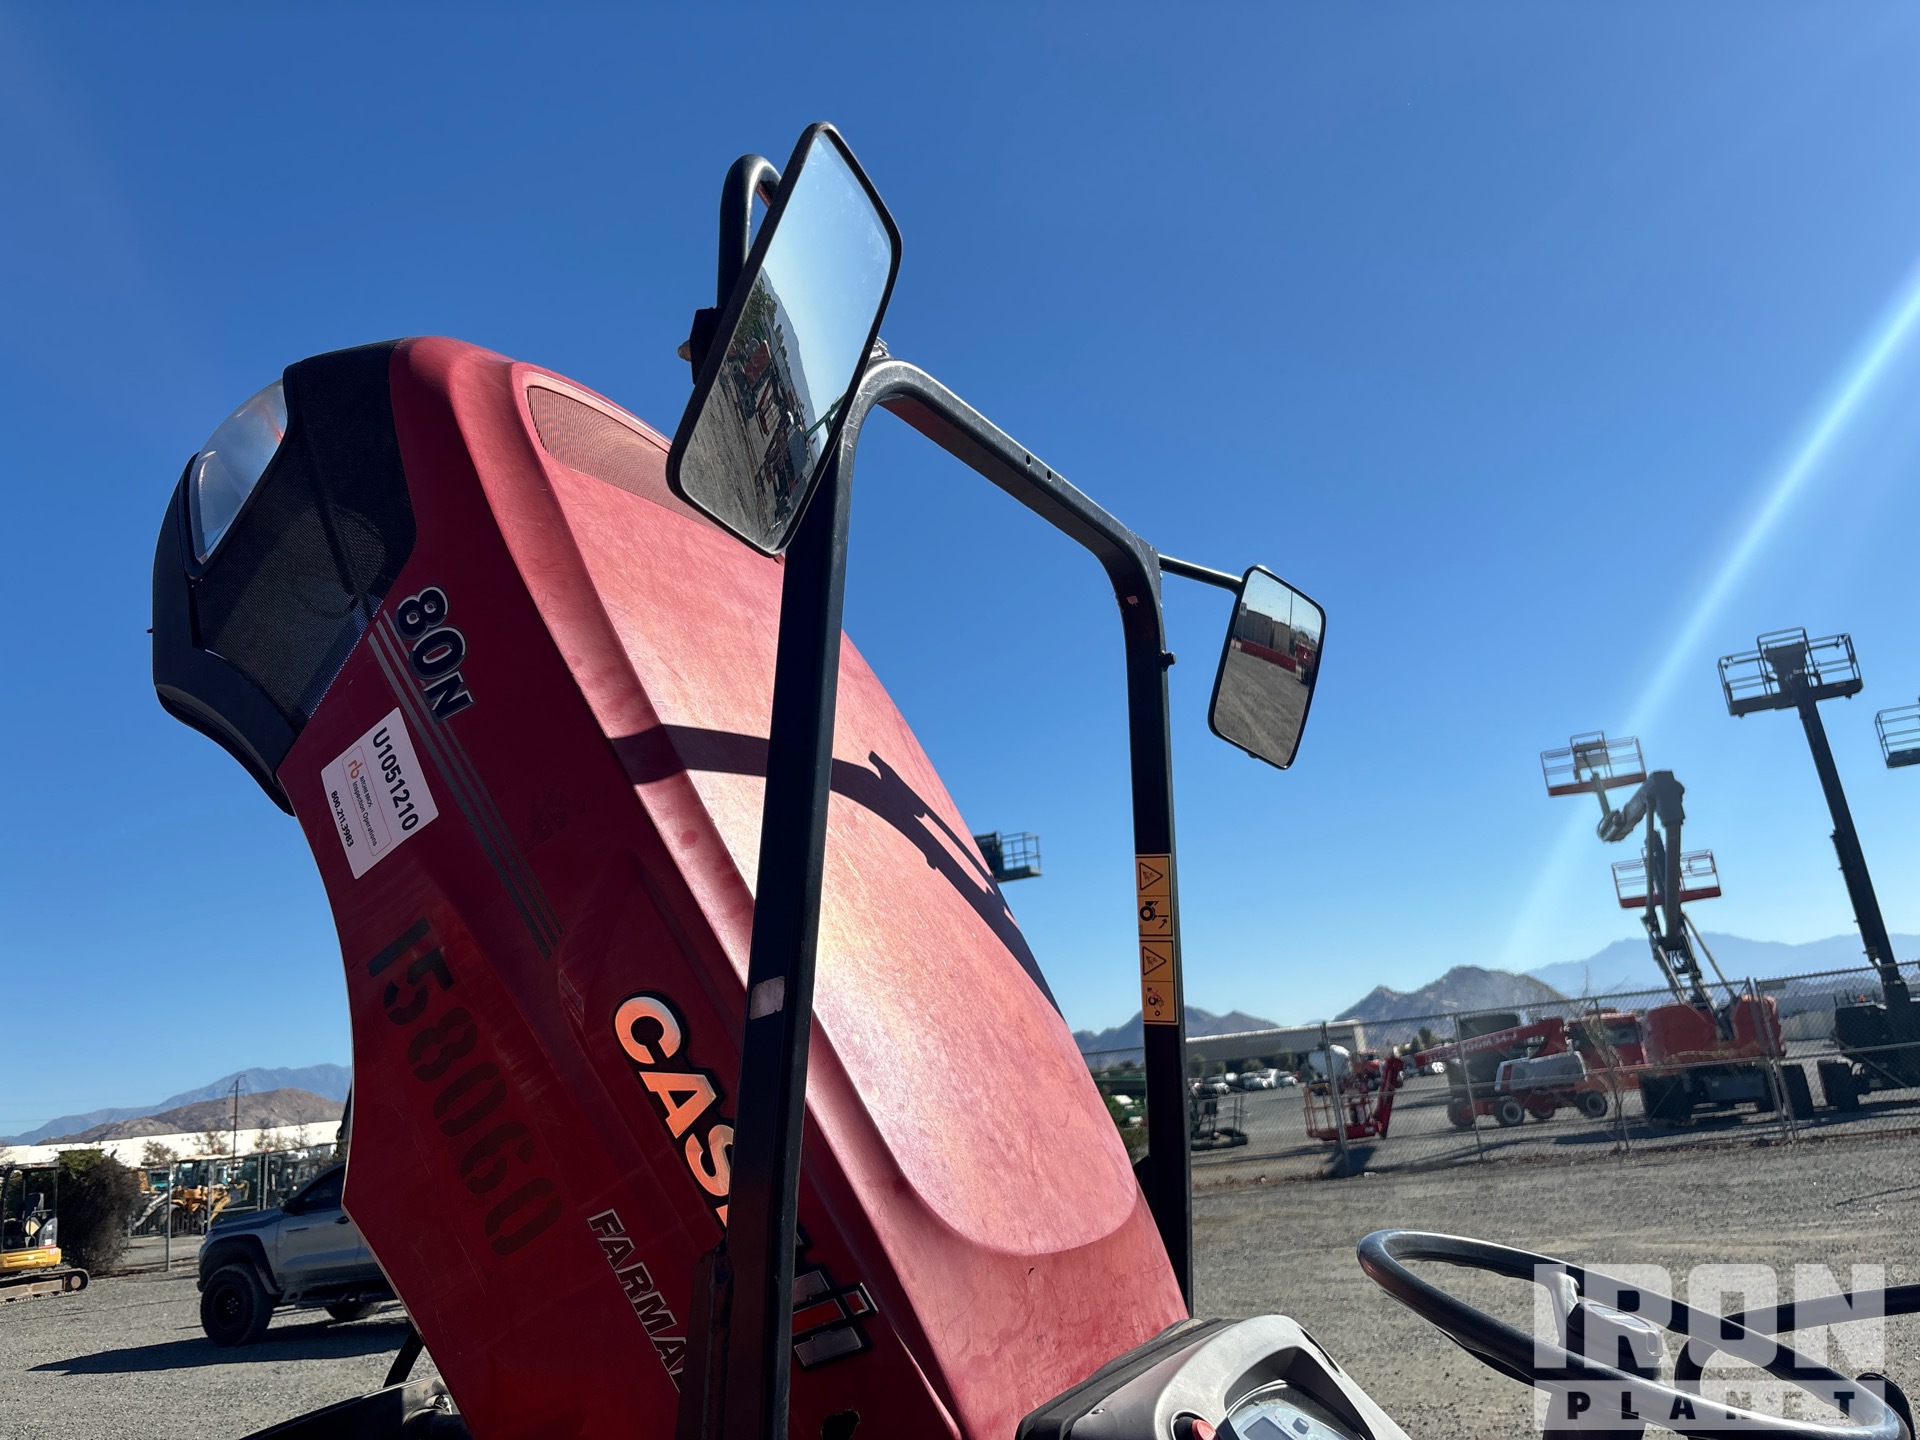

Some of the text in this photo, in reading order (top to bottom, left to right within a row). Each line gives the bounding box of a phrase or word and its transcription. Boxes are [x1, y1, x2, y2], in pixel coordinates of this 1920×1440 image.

[395, 586, 475, 723] 80N
[331, 790, 355, 848] 800.211.3983
[352, 781, 378, 847] Inspection Operations
[372, 727, 419, 831] U1051210
[614, 994, 750, 1235] CAS
